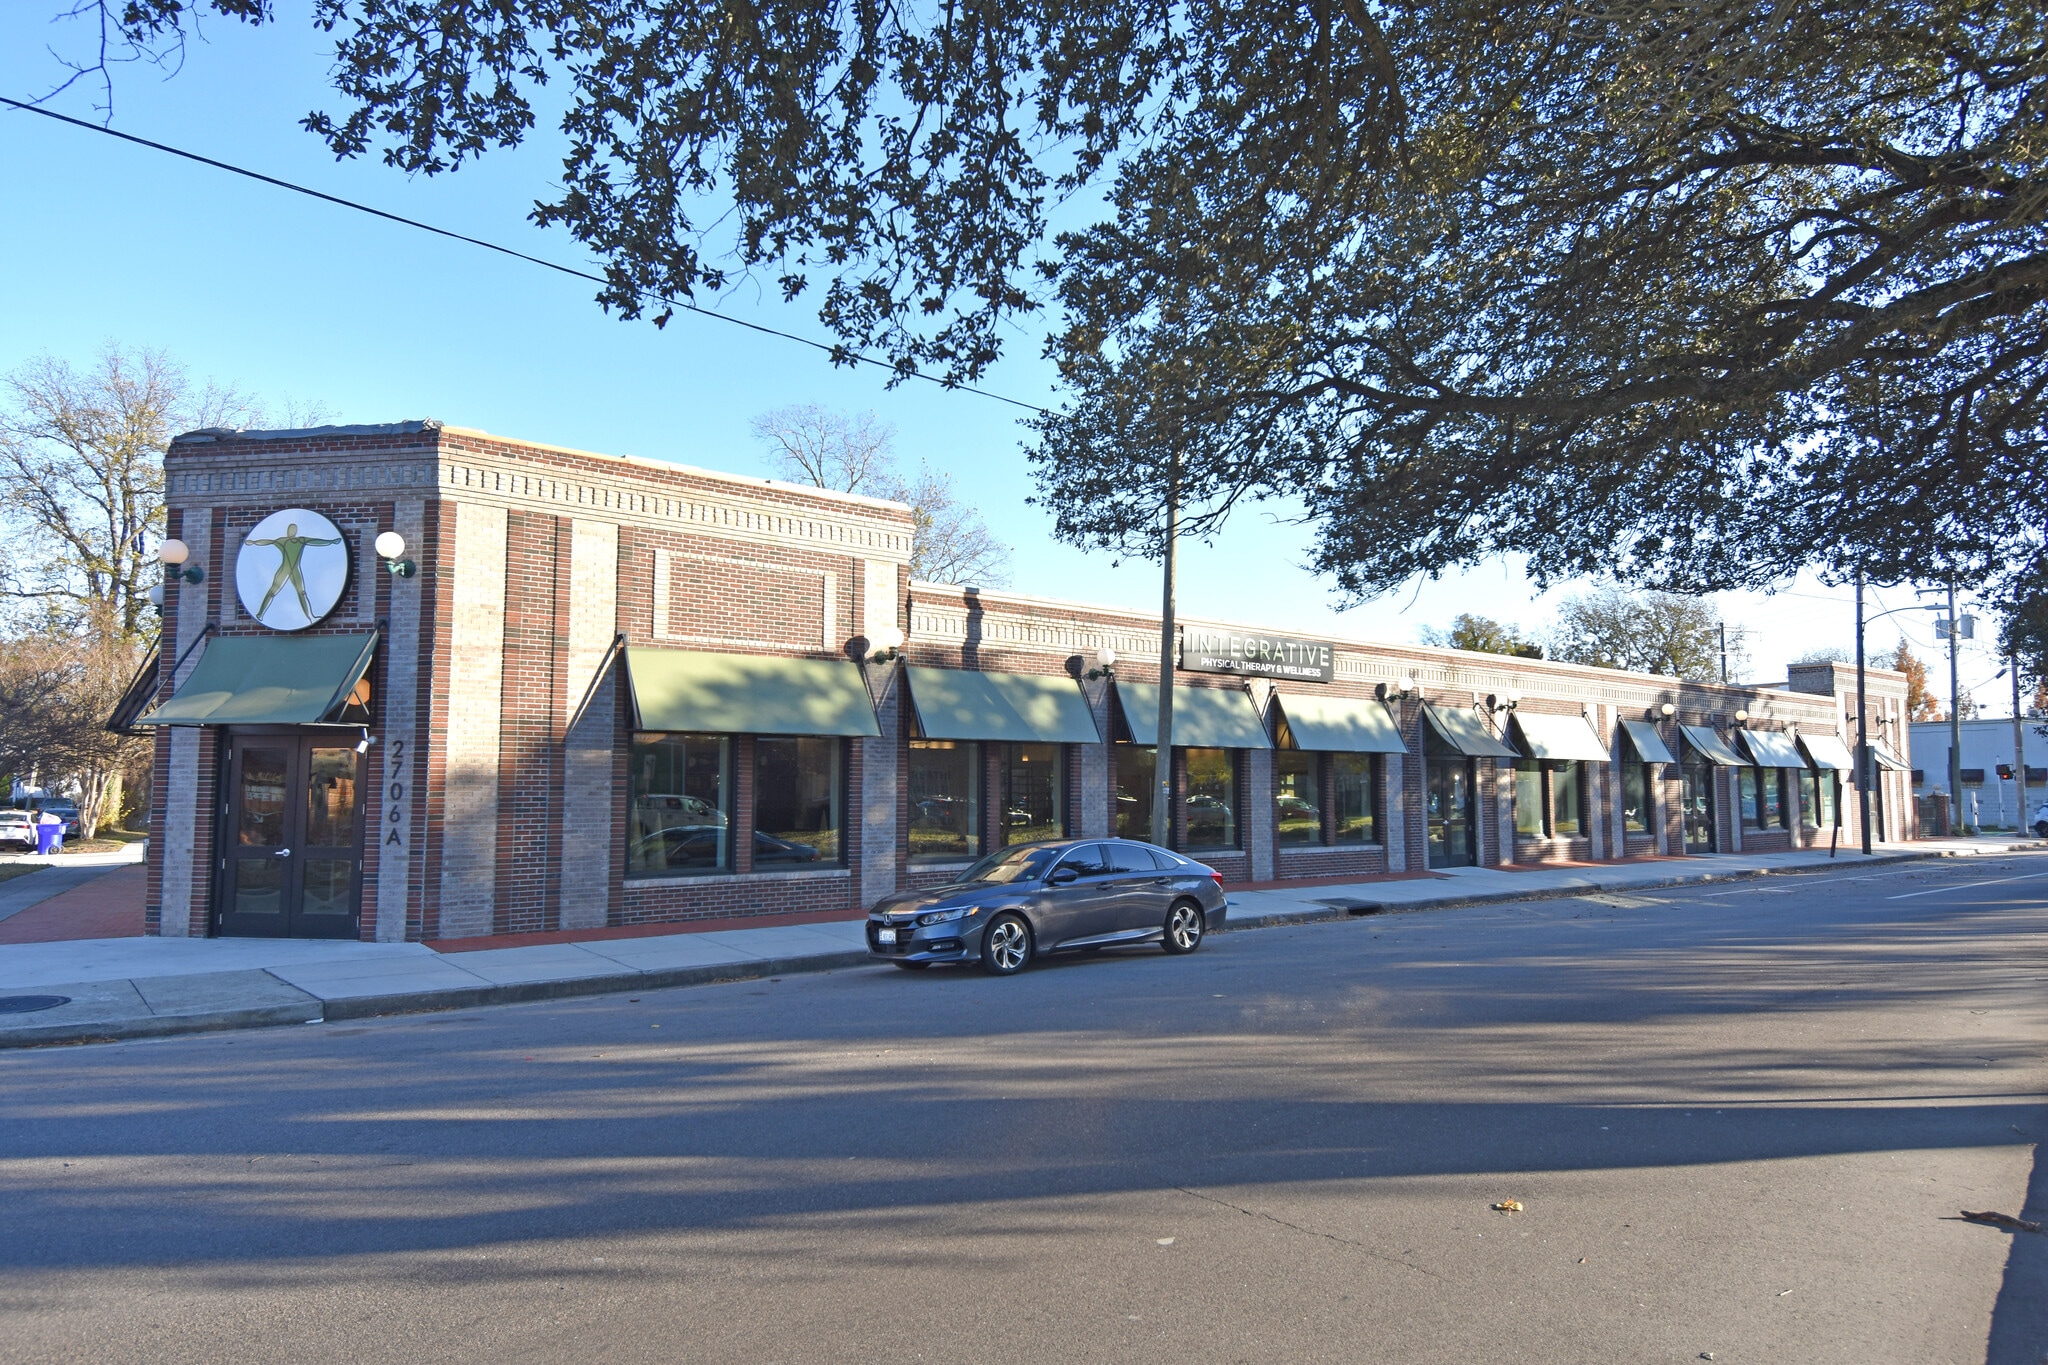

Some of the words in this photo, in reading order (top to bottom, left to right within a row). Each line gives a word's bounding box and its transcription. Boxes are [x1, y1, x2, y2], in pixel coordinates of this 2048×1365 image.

[1189, 632, 1330, 667] INTEGRATIVE
[1200, 657, 1240, 670] PHYSICAL
[1241, 661, 1276, 673] THERAPY
[1276, 665, 1282, 674] &
[1283, 665, 1322, 677] WELLNESS
[386, 740, 404, 846] 2706A
